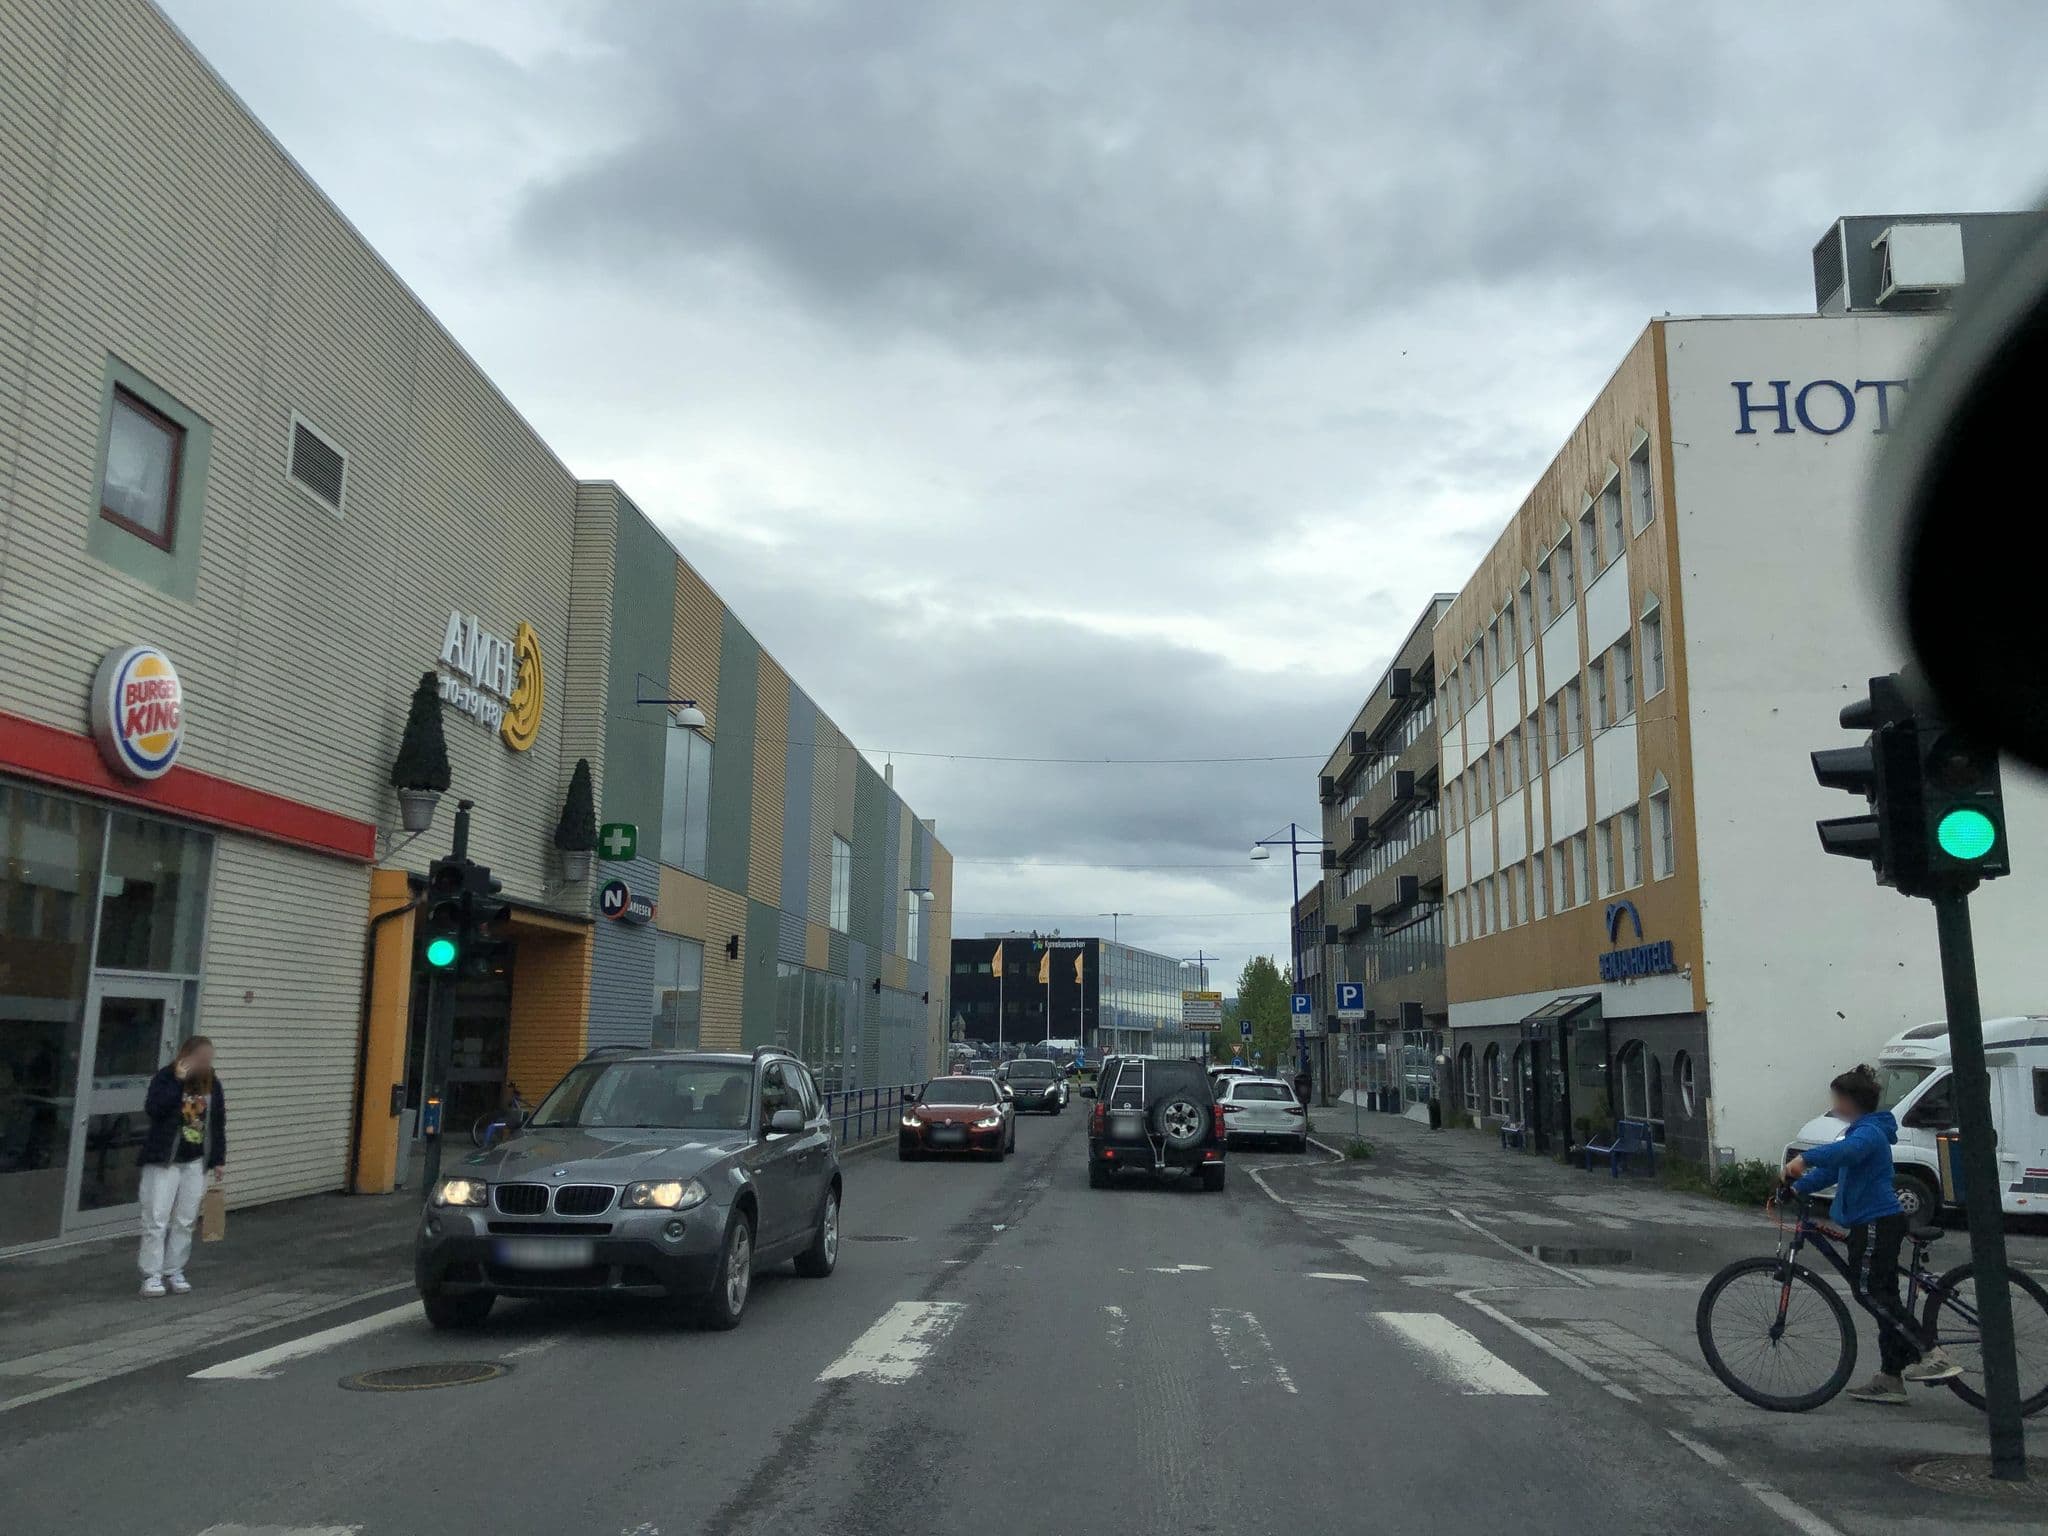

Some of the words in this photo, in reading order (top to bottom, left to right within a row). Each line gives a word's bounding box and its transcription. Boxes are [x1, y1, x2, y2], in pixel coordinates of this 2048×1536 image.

[124, 702, 182, 738] KING
[604, 889, 622, 908] N
[1295, 996, 1307, 1012] P
[1343, 985, 1357, 1007] P
[1242, 1021, 1249, 1033] P
